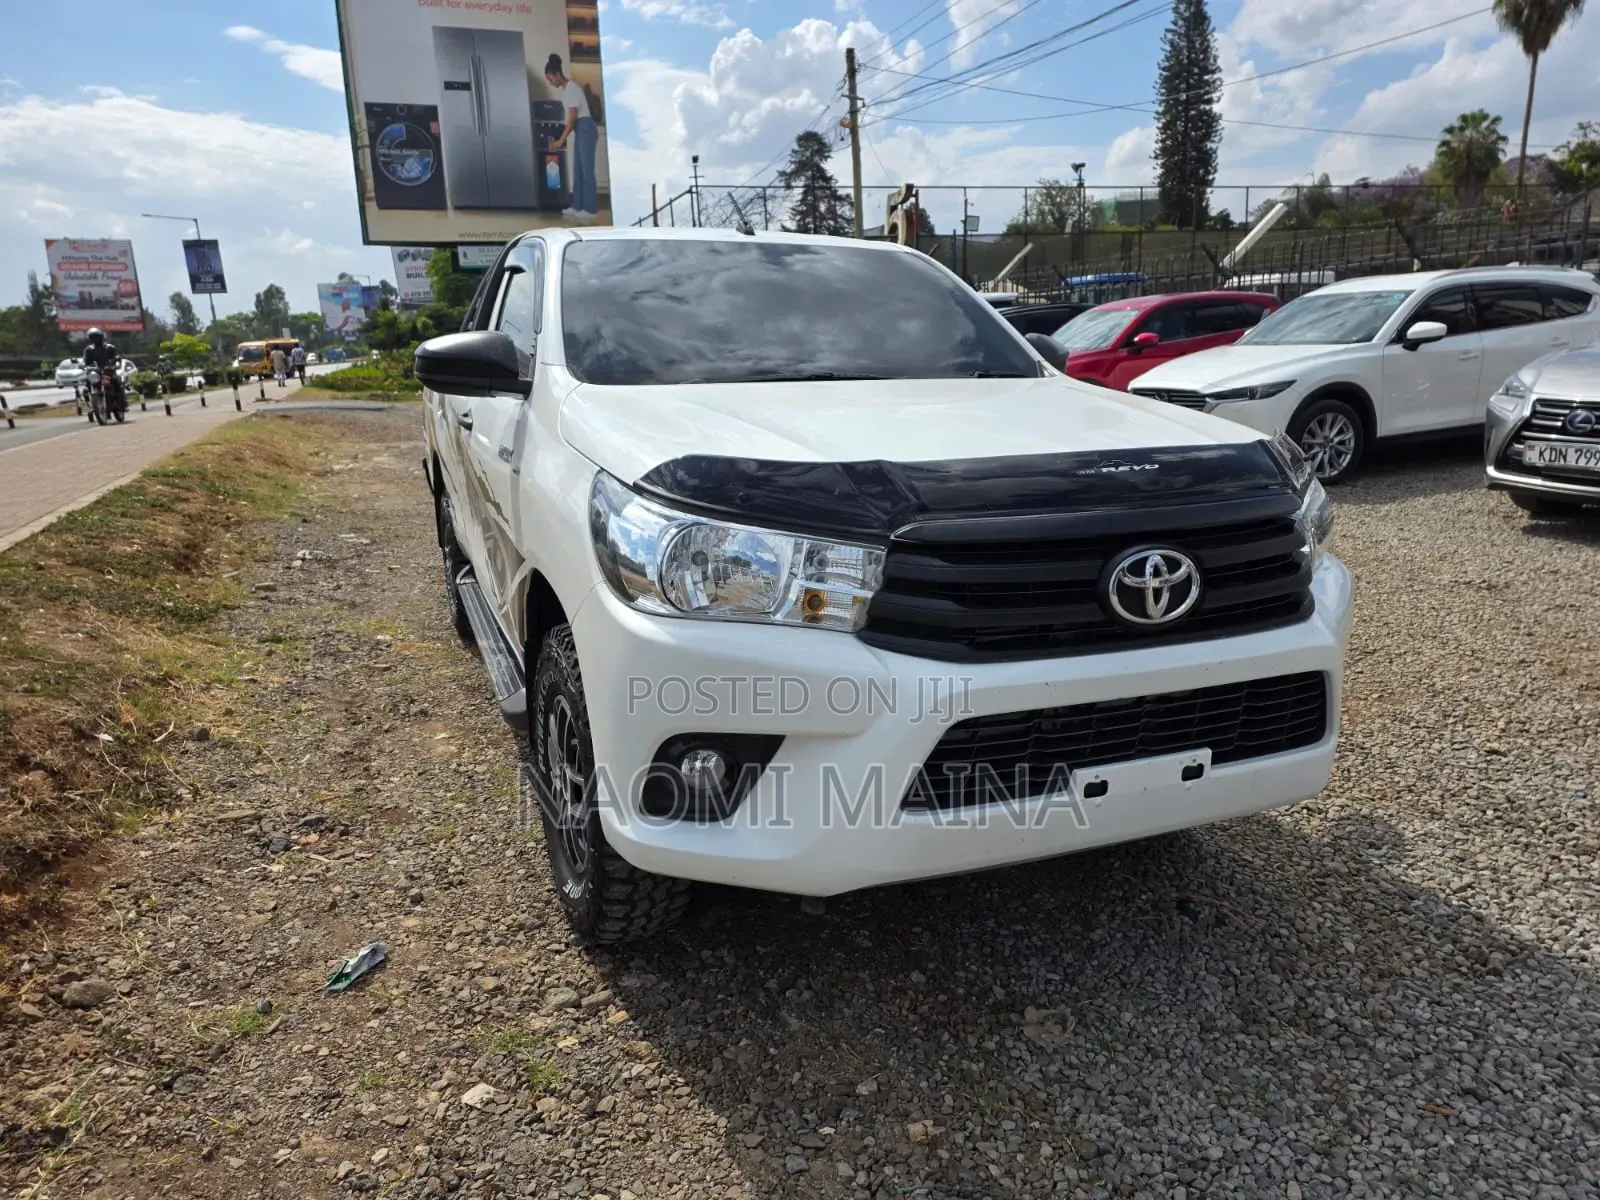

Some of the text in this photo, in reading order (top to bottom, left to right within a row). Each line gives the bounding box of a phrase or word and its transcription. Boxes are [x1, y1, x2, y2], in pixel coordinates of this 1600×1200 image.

[447, 0, 461, 9] for
[464, 2, 513, 14] everyday
[515, 2, 532, 13] life
[1538, 446, 1600, 466] KDN 799
[1101, 463, 1160, 473] REVO
